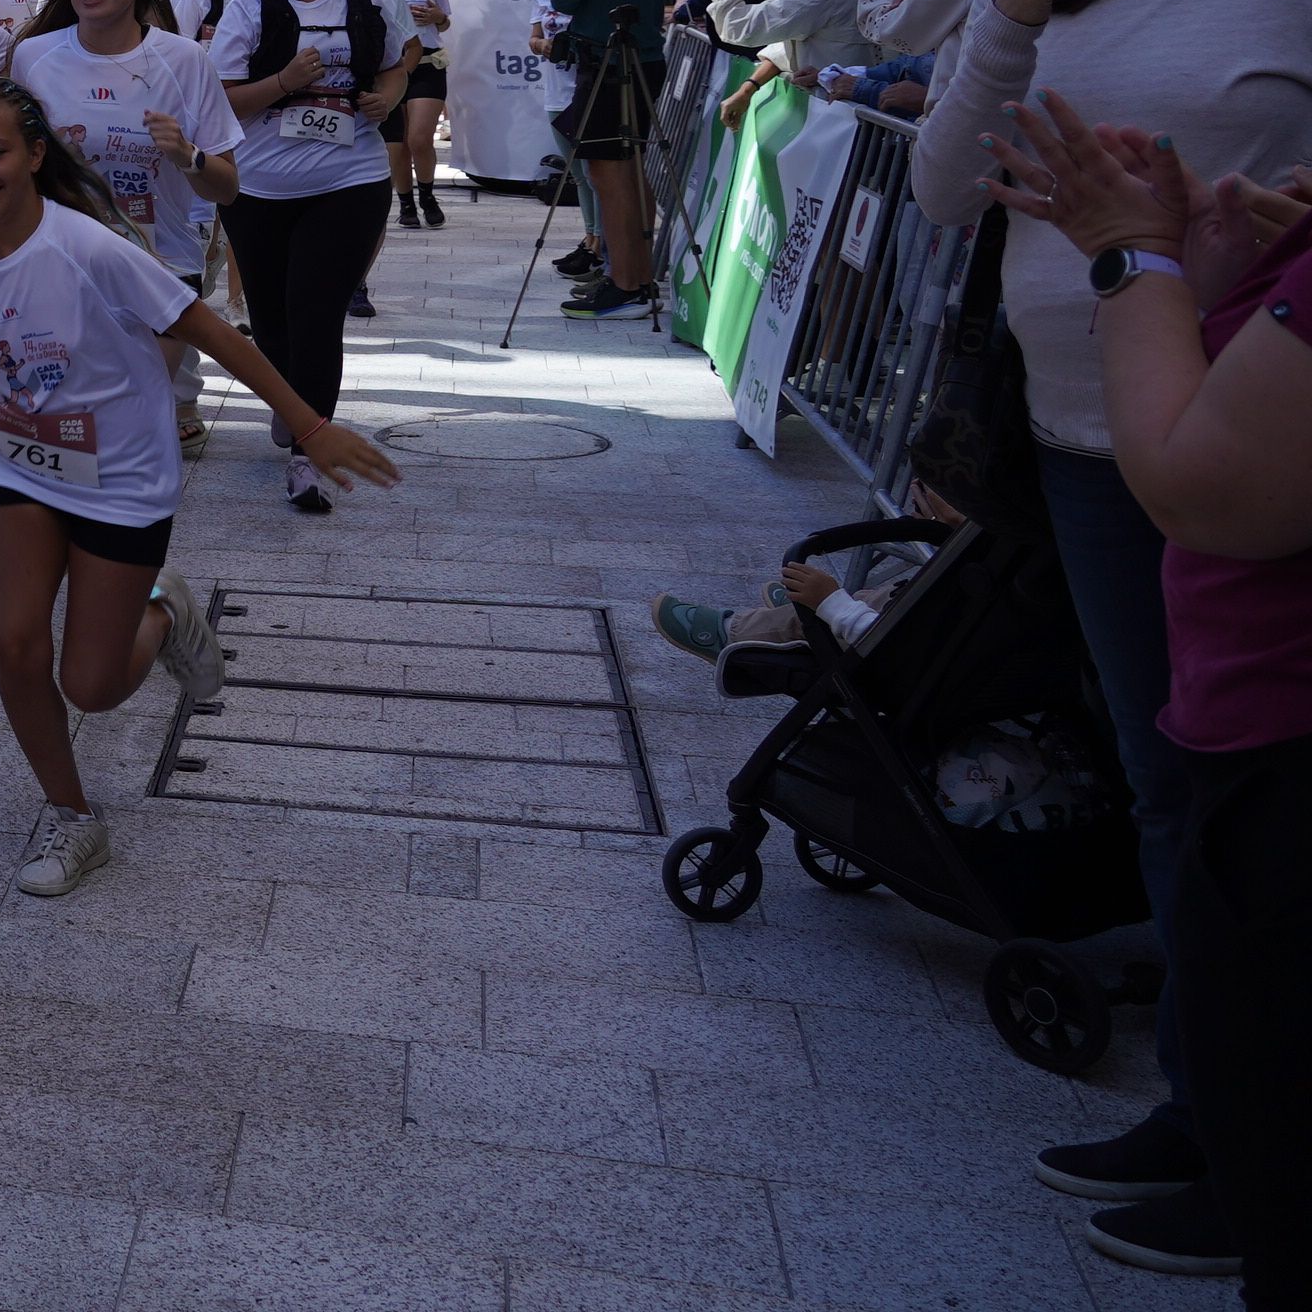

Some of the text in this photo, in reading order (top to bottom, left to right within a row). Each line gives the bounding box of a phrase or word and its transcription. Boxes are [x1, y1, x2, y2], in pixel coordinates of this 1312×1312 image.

[88, 88, 116, 100] ADA
[302, 109, 339, 133] 645
[107, 126, 132, 134] MORA
[105, 152, 116, 161] de
[113, 170, 148, 181] CADA
[113, 180, 148, 193] PAS
[37, 363, 62, 374] CADA
[41, 372, 65, 382] PAS
[59, 419, 84, 427] CADA
[60, 427, 85, 435] PAS
[7, 440, 63, 472] 761
